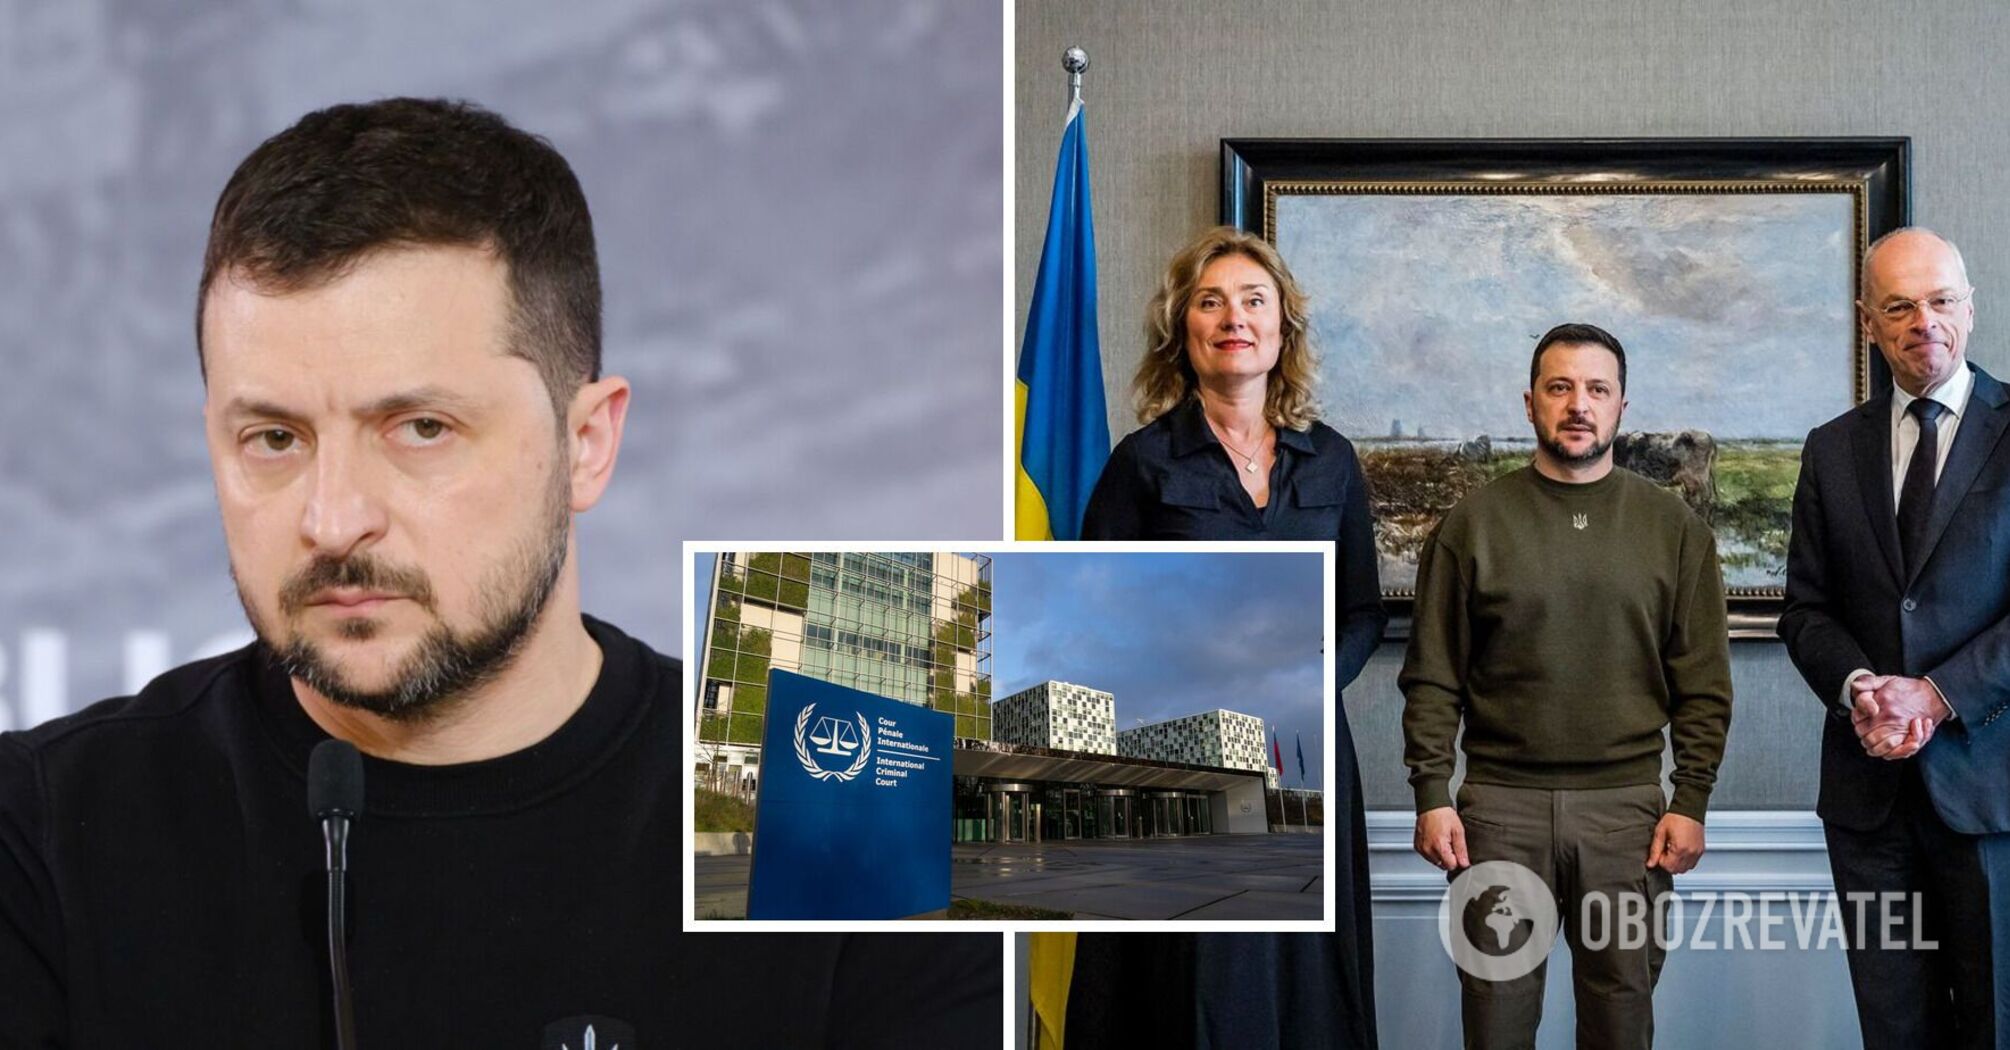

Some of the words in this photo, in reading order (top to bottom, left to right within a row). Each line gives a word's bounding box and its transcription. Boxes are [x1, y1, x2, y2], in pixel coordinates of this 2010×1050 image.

[878, 717, 896, 727] Cour
[878, 727, 904, 738] Pénale
[877, 737, 929, 752] Internationale
[877, 757, 925, 770] International
[876, 767, 908, 777] Criminal
[875, 777, 897, 787] Court
